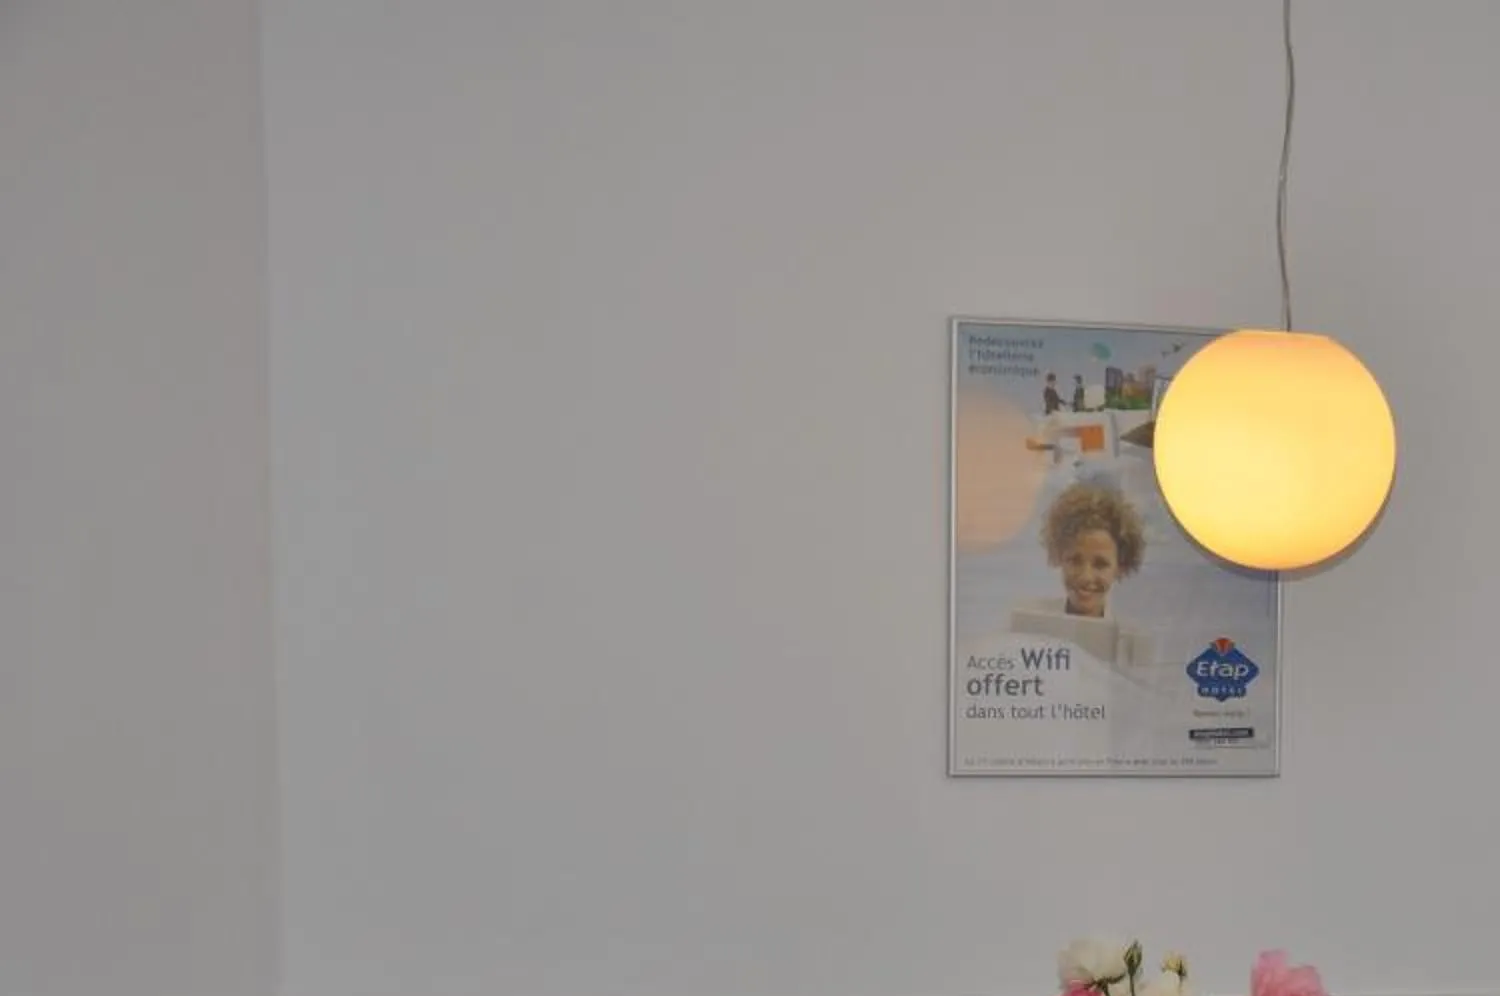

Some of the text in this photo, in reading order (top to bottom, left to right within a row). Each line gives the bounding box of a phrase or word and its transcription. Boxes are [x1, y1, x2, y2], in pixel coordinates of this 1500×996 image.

[1021, 646, 1071, 671] Wifi
[1196, 661, 1249, 680] Etap
[966, 672, 1045, 696] offert
[965, 702, 1105, 720] dans tout l'hôtel
